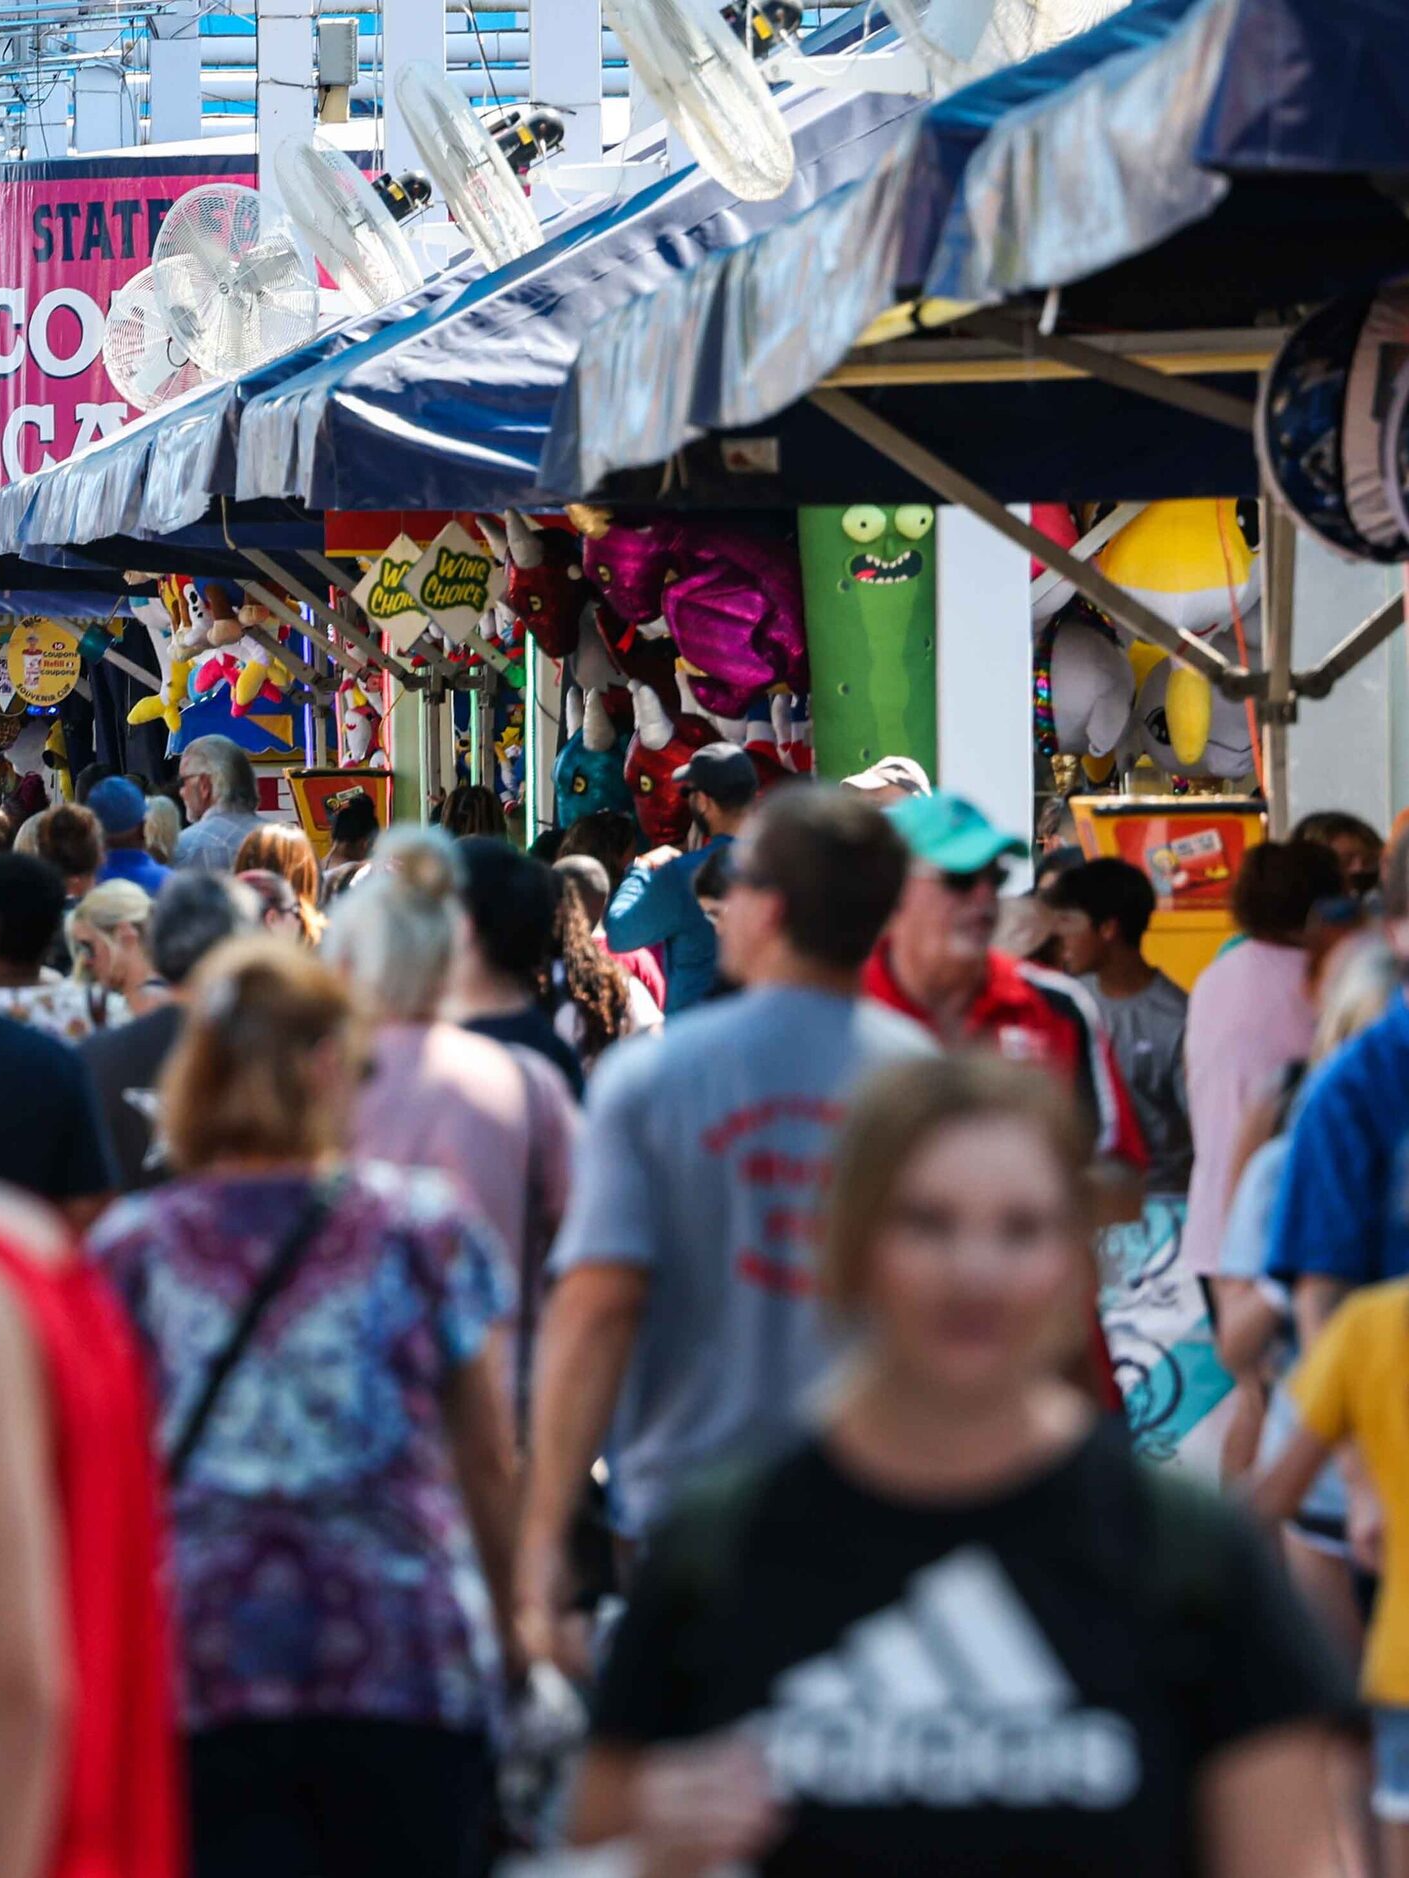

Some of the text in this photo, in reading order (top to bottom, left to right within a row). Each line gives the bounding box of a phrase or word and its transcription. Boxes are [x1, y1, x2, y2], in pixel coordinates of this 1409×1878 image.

[382, 563, 410, 589] W
[424, 575, 483, 606] CHOICE
[16, 683, 57, 701] SOUVENIR
